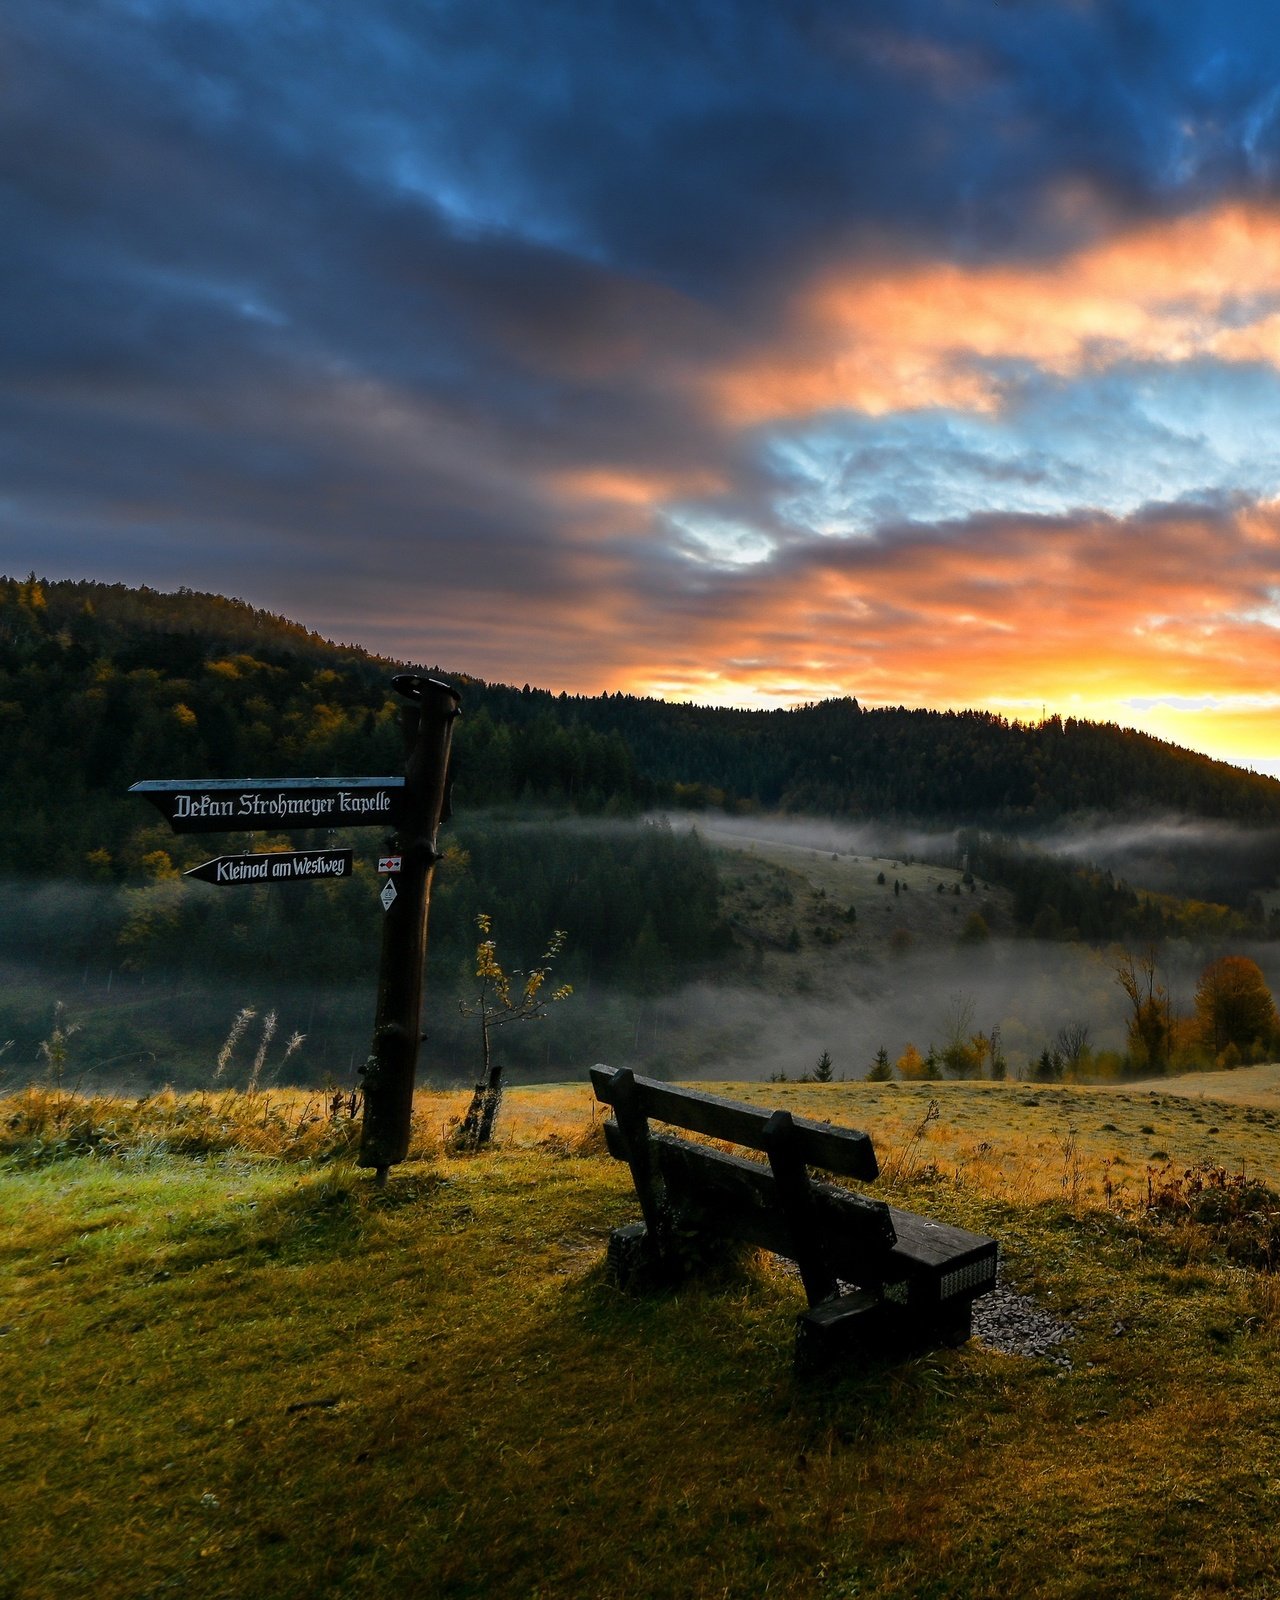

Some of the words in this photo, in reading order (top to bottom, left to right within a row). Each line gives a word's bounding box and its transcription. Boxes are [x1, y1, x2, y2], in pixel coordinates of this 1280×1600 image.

[172, 795, 234, 818] Dekan
[238, 793, 335, 818] Strohmeyer
[337, 791, 391, 814] Kapelle
[216, 859, 269, 881] Kleinod
[272, 862, 291, 877] am
[292, 856, 345, 876] Westweg
